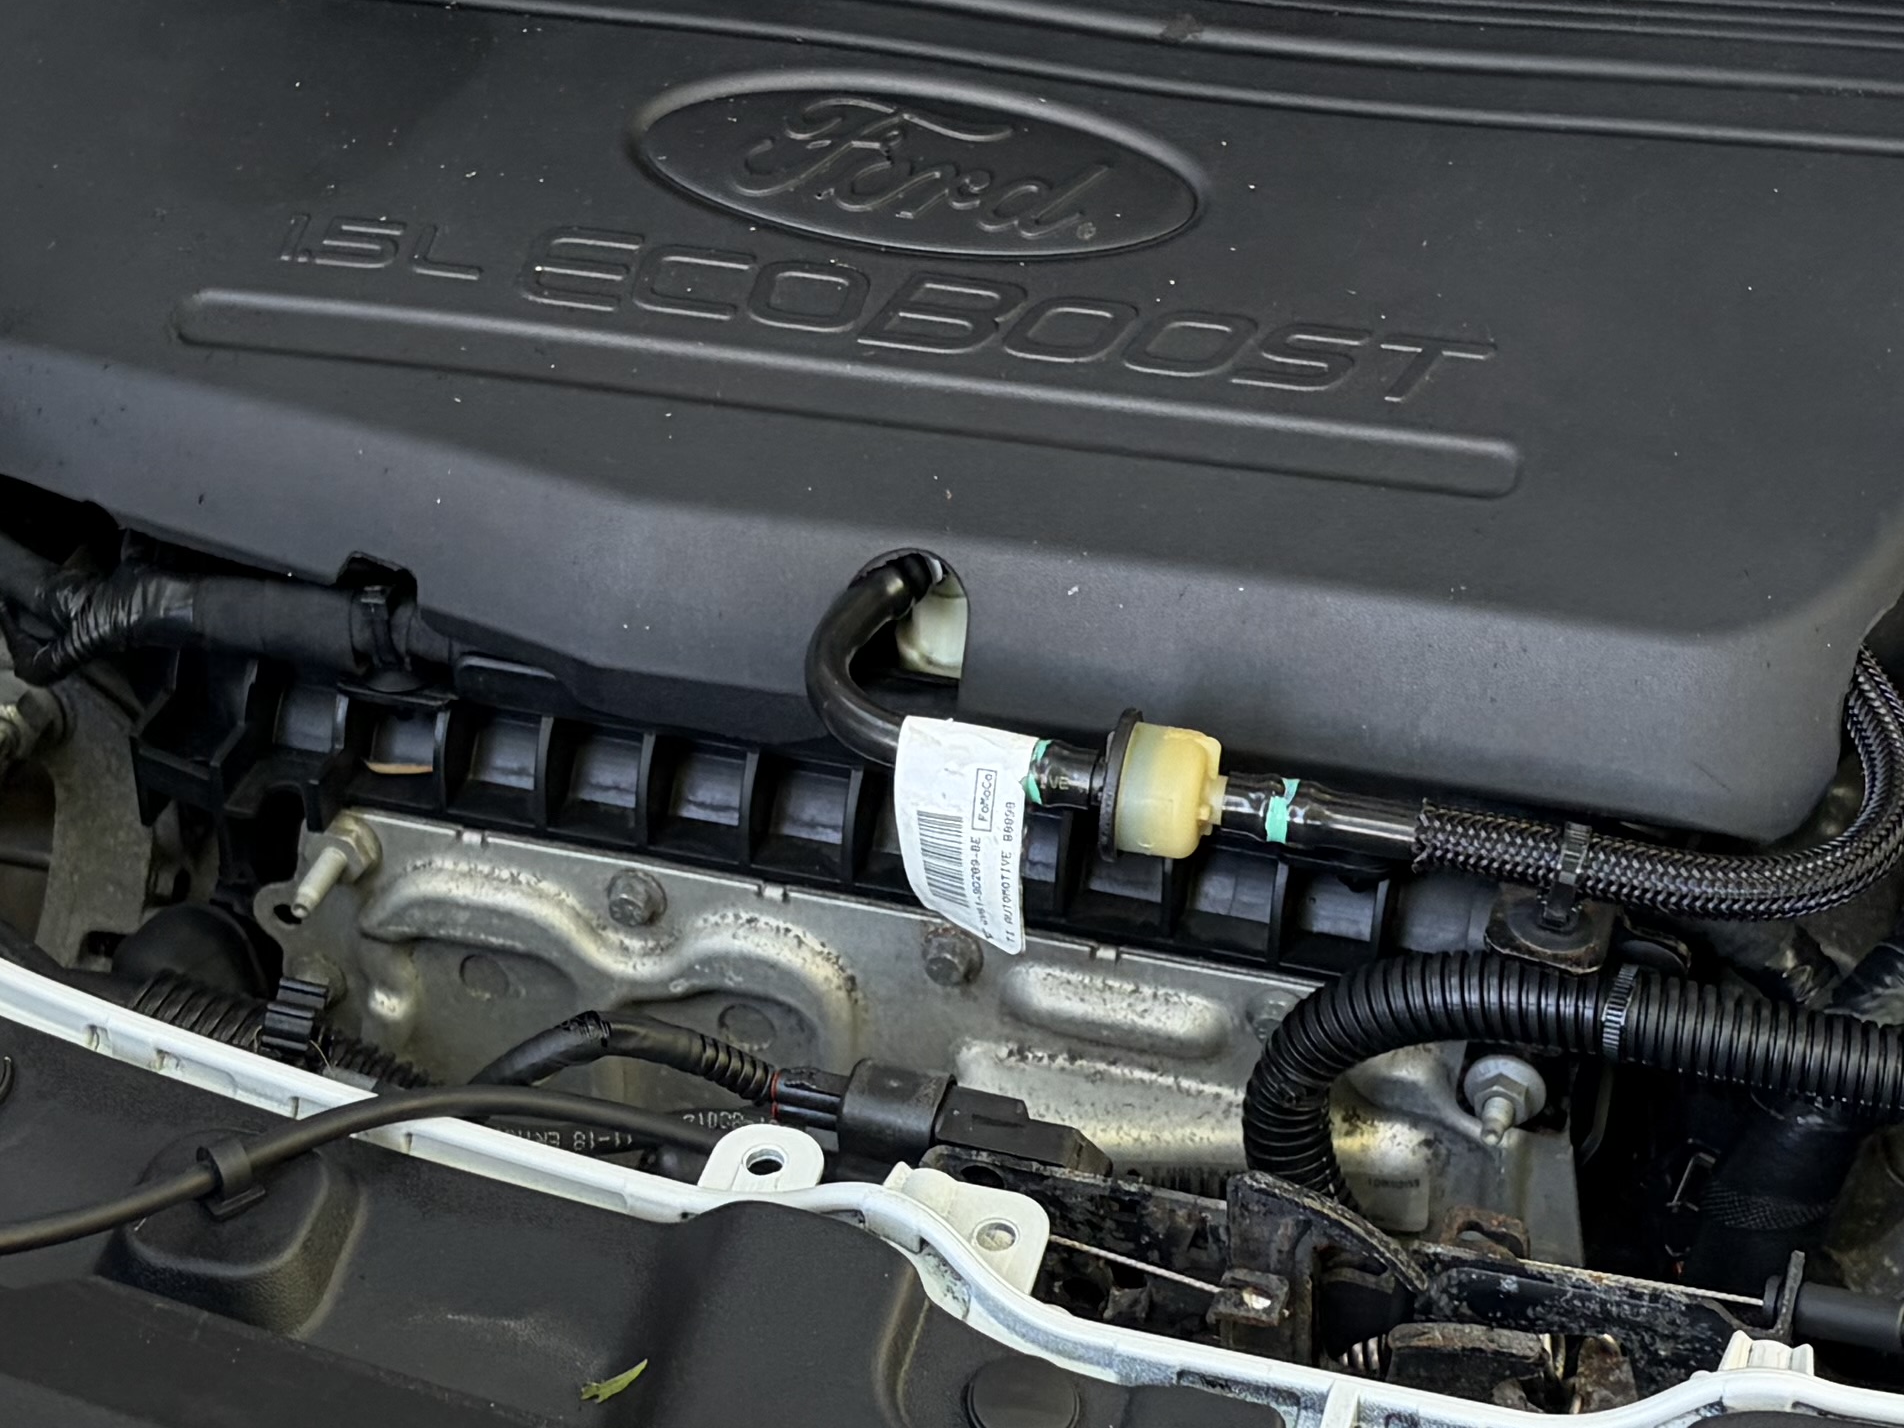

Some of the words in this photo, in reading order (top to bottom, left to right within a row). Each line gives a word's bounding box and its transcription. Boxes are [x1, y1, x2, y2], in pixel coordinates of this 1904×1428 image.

[734, 97, 1110, 240] Ford
[978, 773, 993, 823] FoMoCo
[1001, 850, 1013, 925] AUTOMOTIVE
